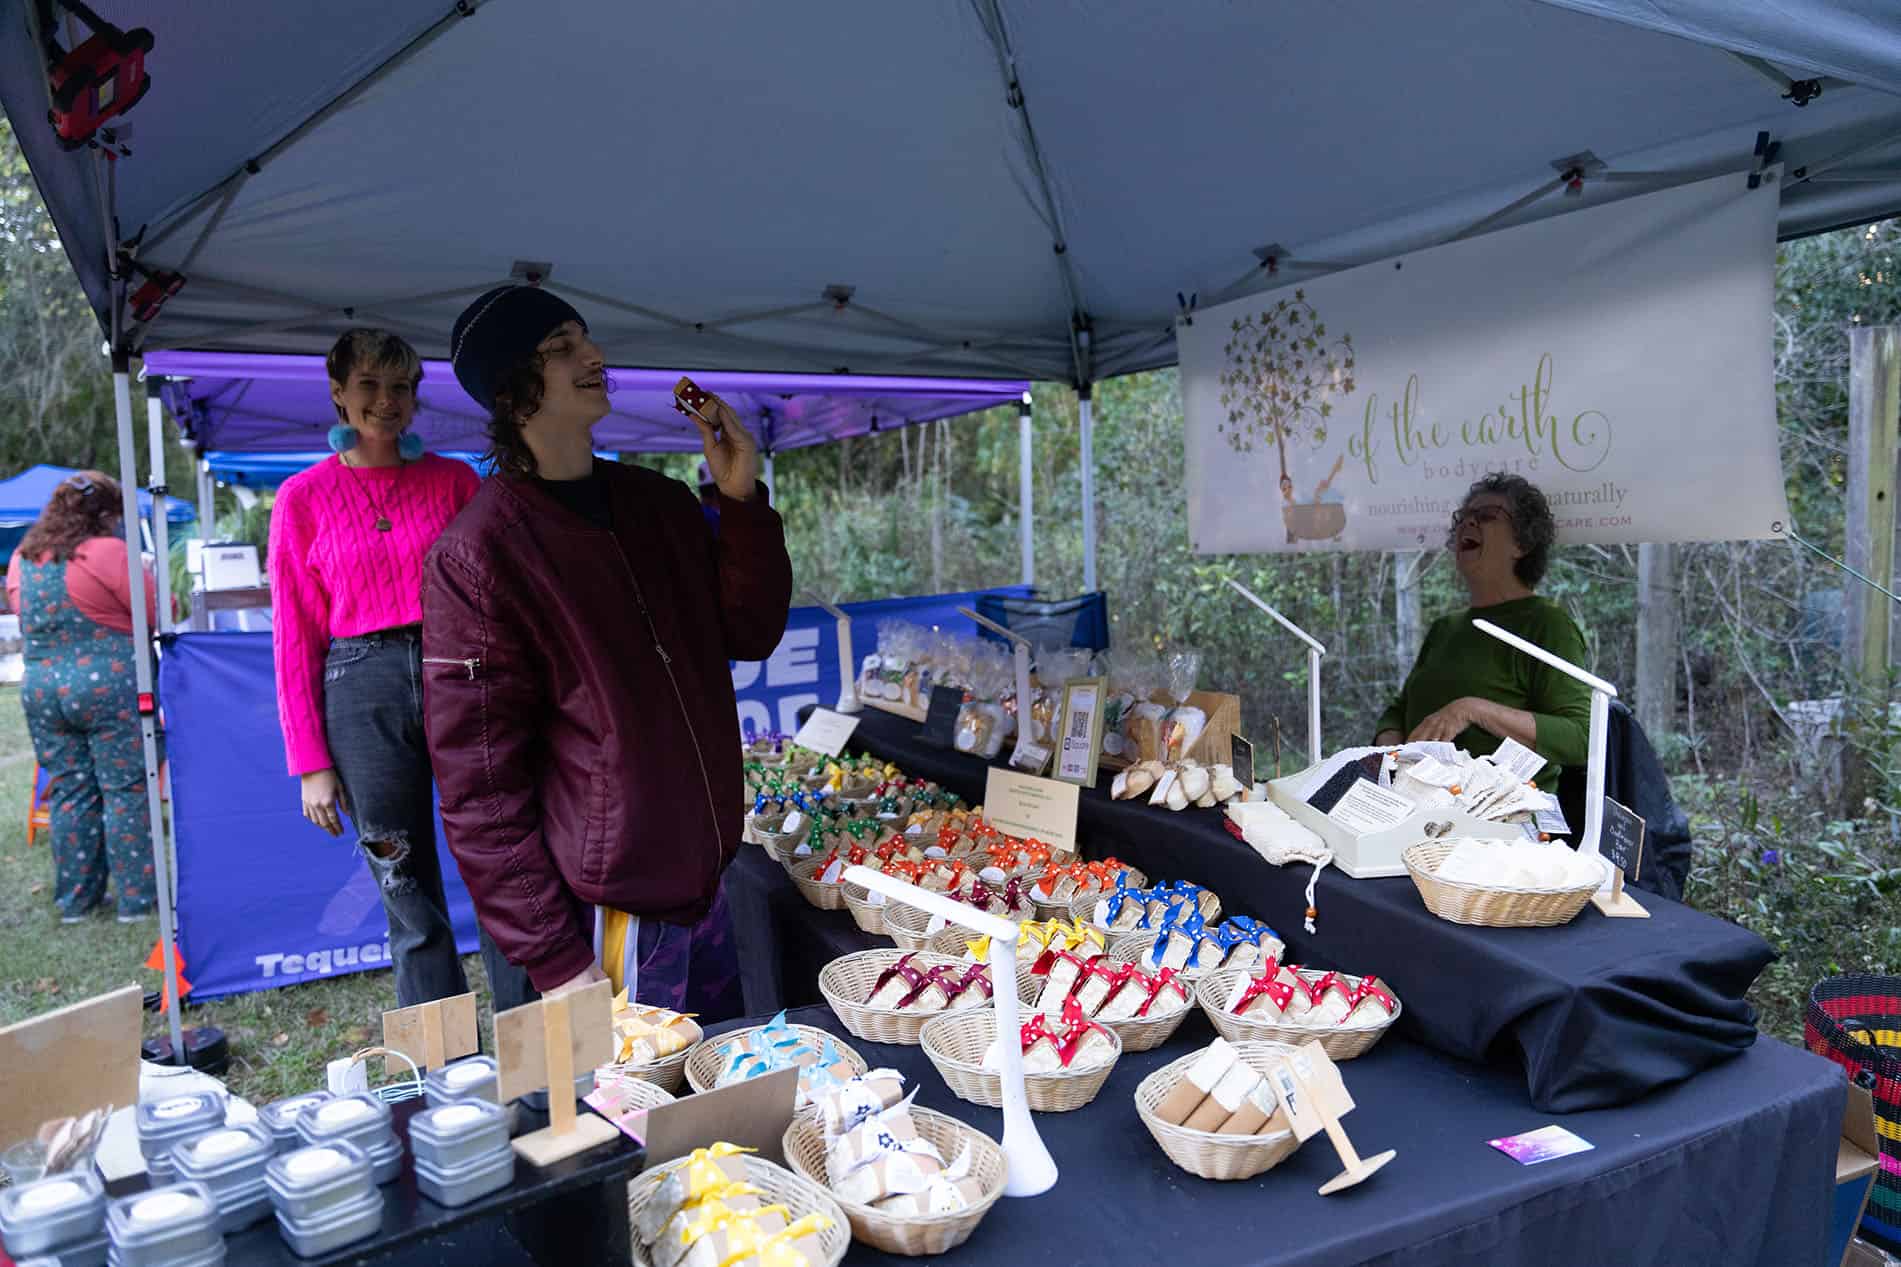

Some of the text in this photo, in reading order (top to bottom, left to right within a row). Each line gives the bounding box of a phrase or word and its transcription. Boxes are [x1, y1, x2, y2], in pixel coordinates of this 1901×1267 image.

[1348, 351, 1611, 485] of the earth
[1423, 455, 1541, 482] bodycare
[1366, 494, 1451, 519] nourishing
